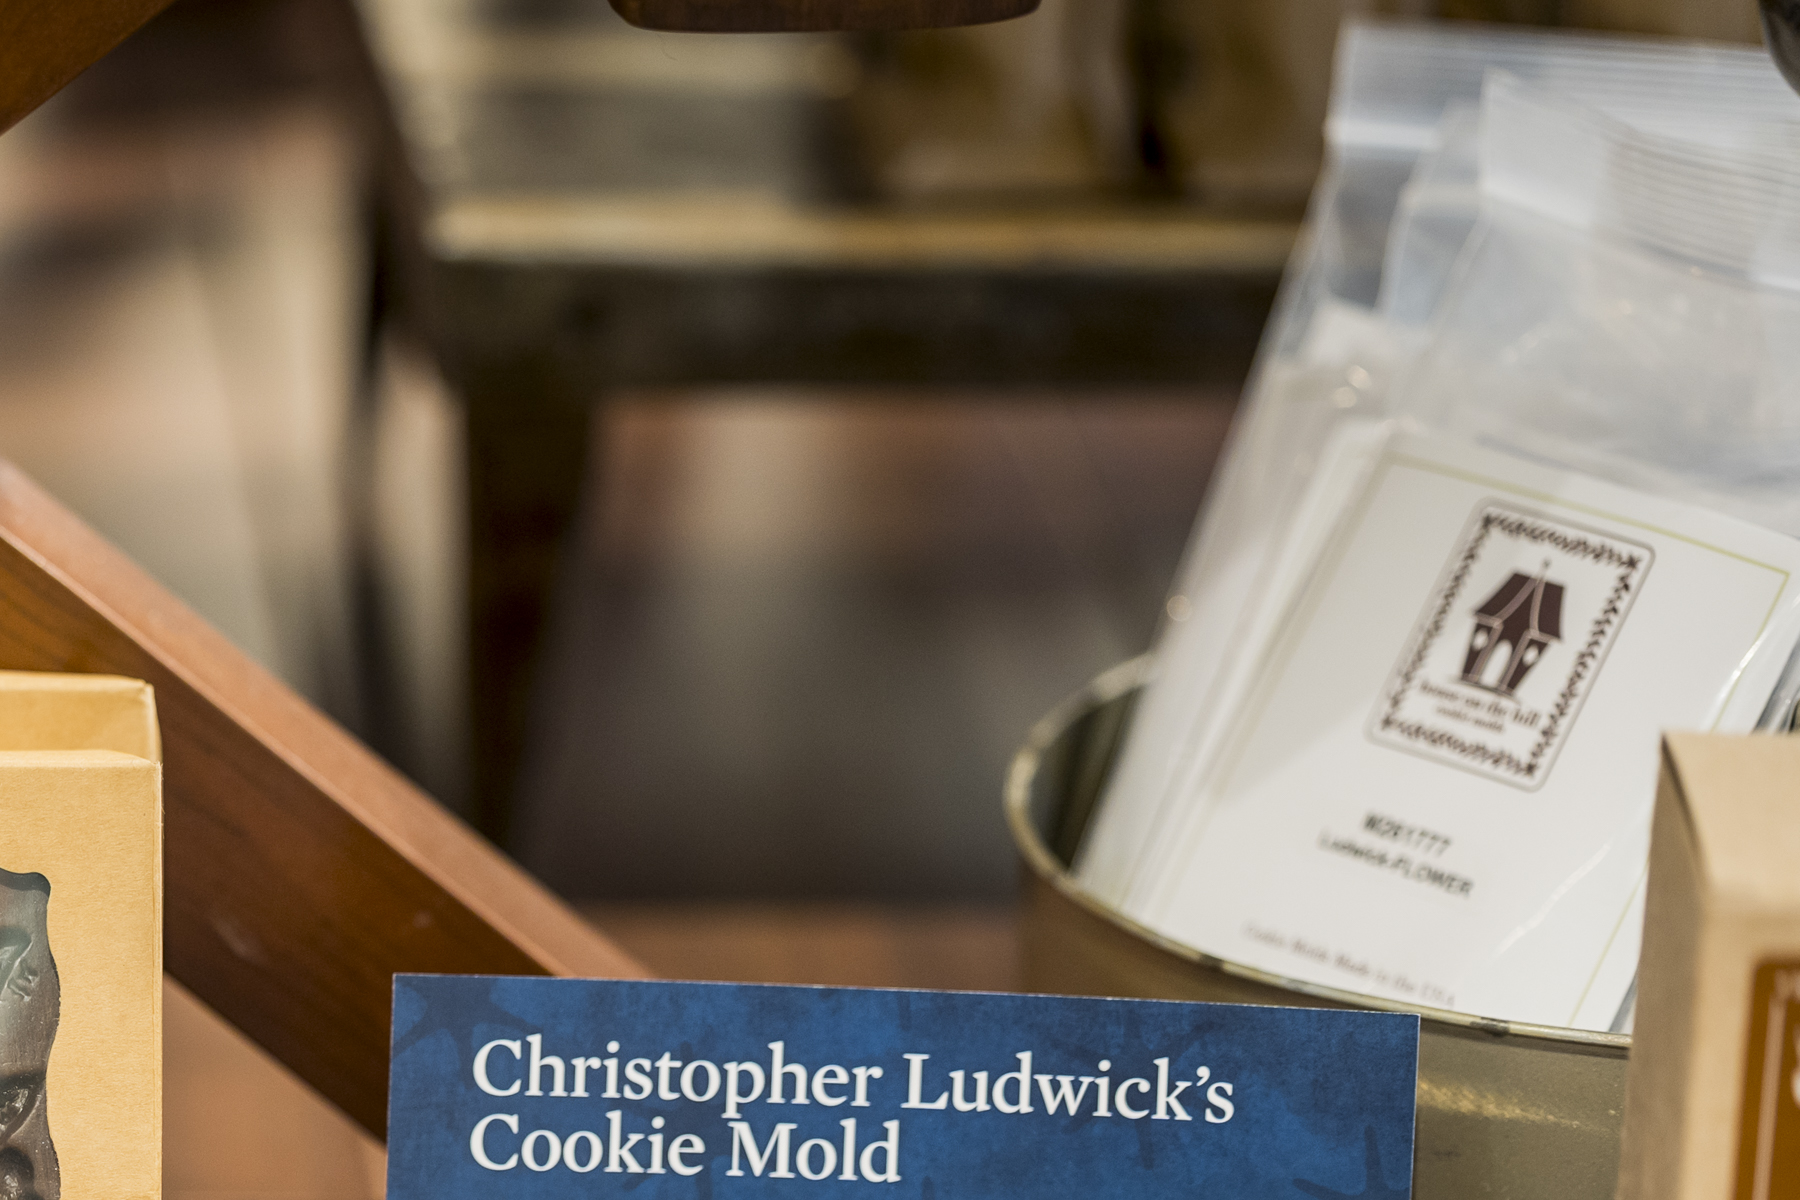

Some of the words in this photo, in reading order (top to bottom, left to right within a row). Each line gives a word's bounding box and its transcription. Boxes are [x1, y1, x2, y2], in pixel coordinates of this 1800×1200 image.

[473, 1034, 883, 1118] Christopher
[470, 1110, 705, 1175] Cookie
[725, 1118, 901, 1182] Mold
